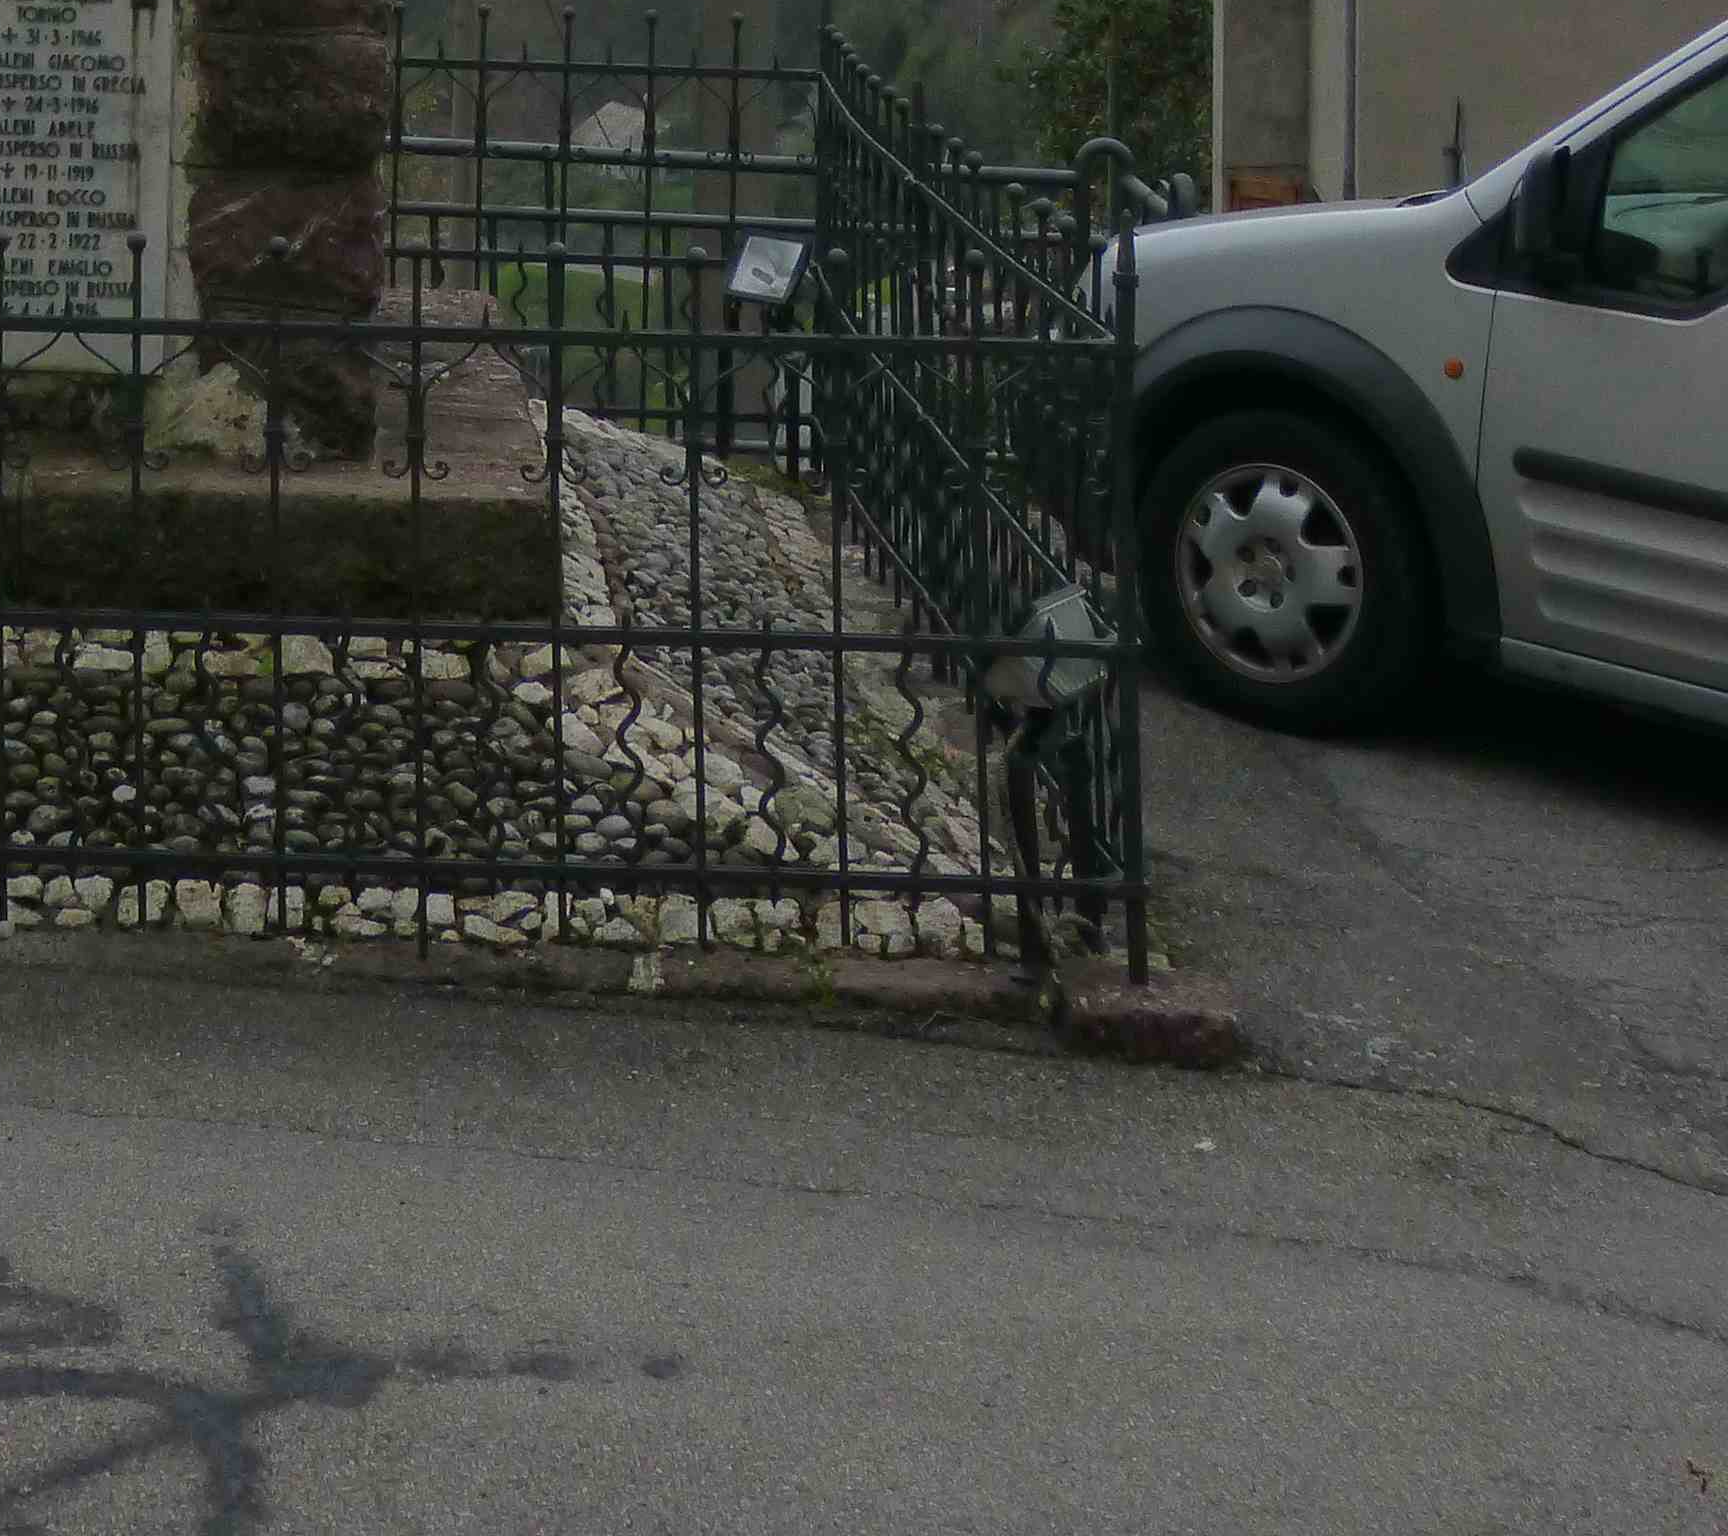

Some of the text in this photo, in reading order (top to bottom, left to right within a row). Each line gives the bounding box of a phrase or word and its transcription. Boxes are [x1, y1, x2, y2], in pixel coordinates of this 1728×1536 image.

[48, 54, 126, 72] GIACOMO
[72, 75, 86, 92] IN
[93, 76, 147, 95] GRECIA
[47, 120, 97, 138] ABELE
[69, 143, 83, 158] IN
[47, 189, 106, 206] ROCCO
[66, 212, 80, 228] IN
[87, 212, 137, 229] RUSSIA
[47, 259, 113, 276] EMIGLIO
[66, 281, 80, 298] IN
